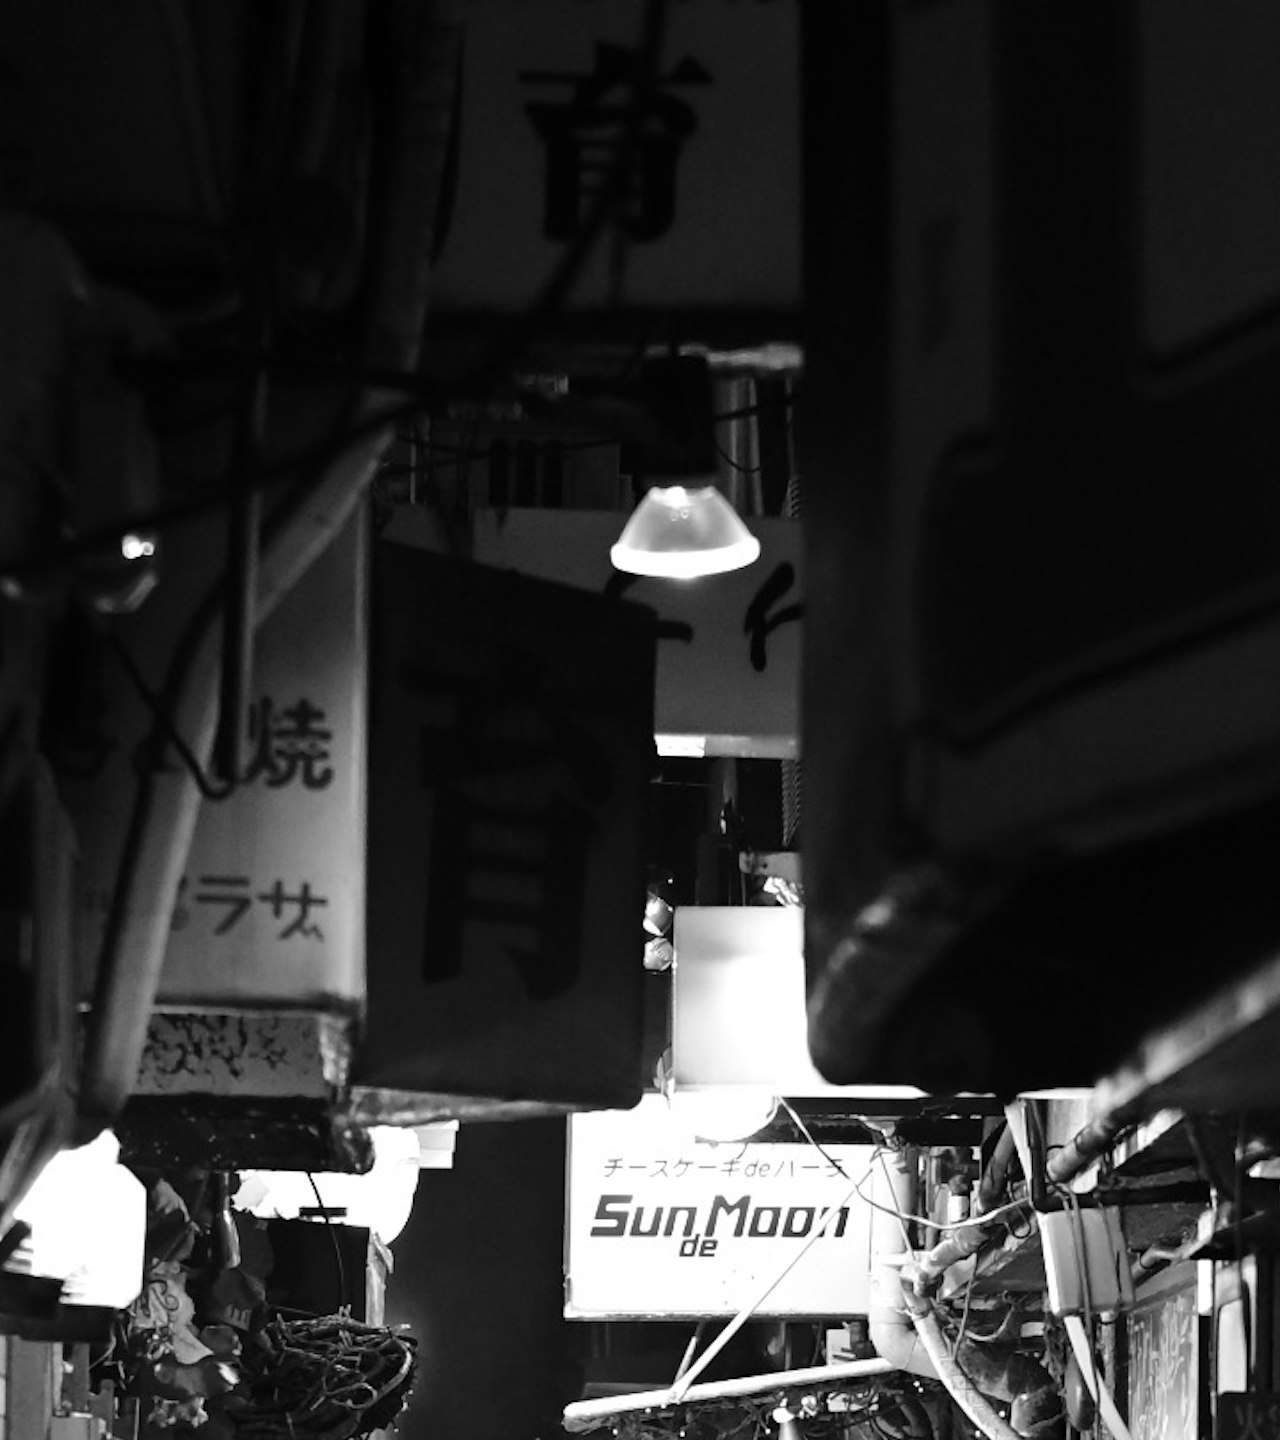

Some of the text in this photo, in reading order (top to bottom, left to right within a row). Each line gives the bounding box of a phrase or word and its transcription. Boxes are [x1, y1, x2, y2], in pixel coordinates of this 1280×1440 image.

[589, 1194, 851, 1239] Sun Moon
[678, 1232, 719, 1258] de
